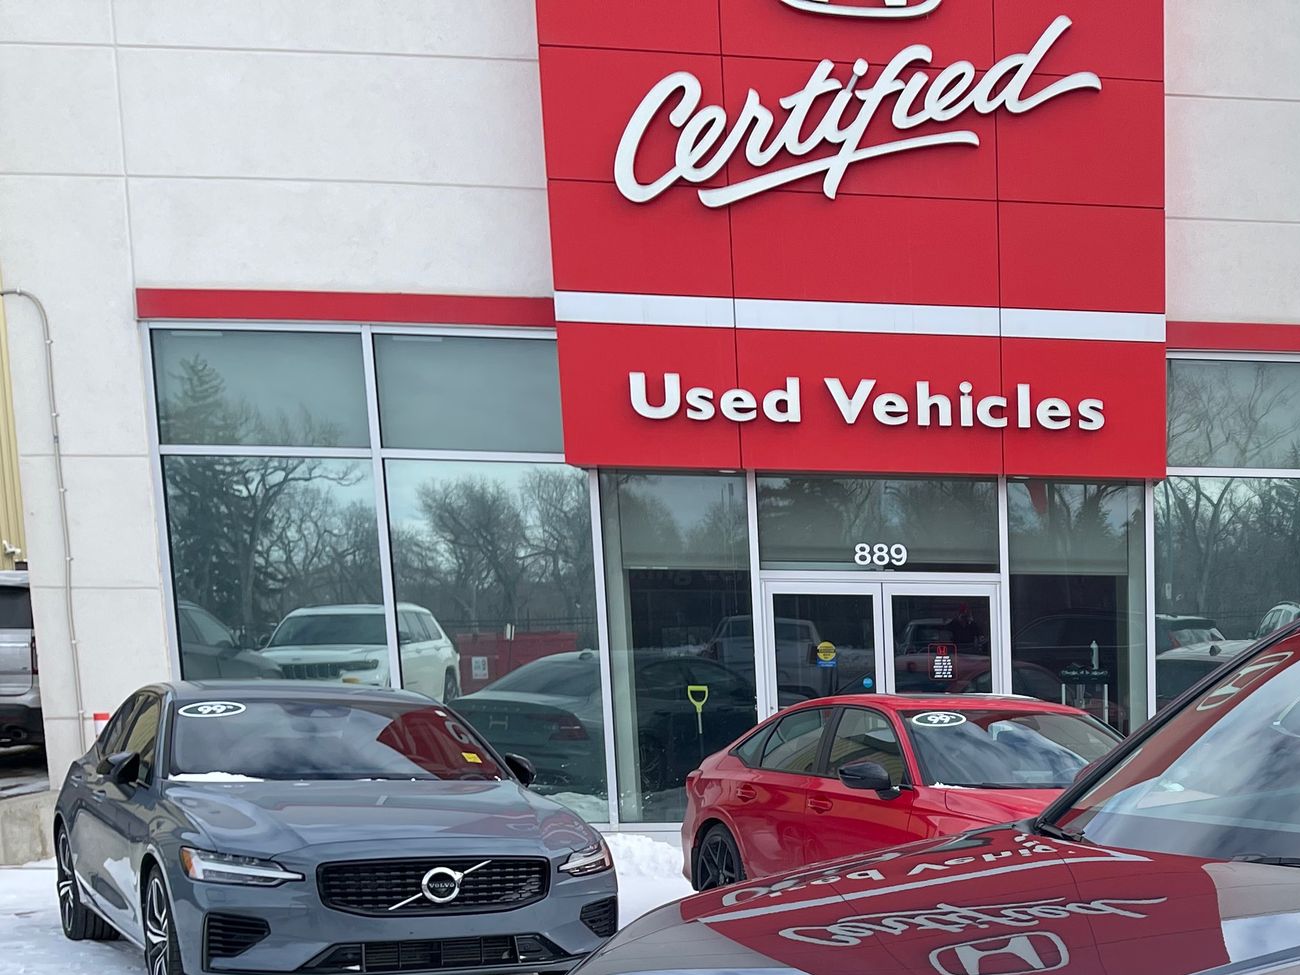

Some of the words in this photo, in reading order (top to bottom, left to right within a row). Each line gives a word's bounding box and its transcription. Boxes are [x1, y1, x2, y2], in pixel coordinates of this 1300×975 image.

[613, 14, 1102, 208] Certified
[628, 371, 800, 424] Used
[824, 377, 1106, 432] Vehicles
[854, 543, 908, 566] 889
